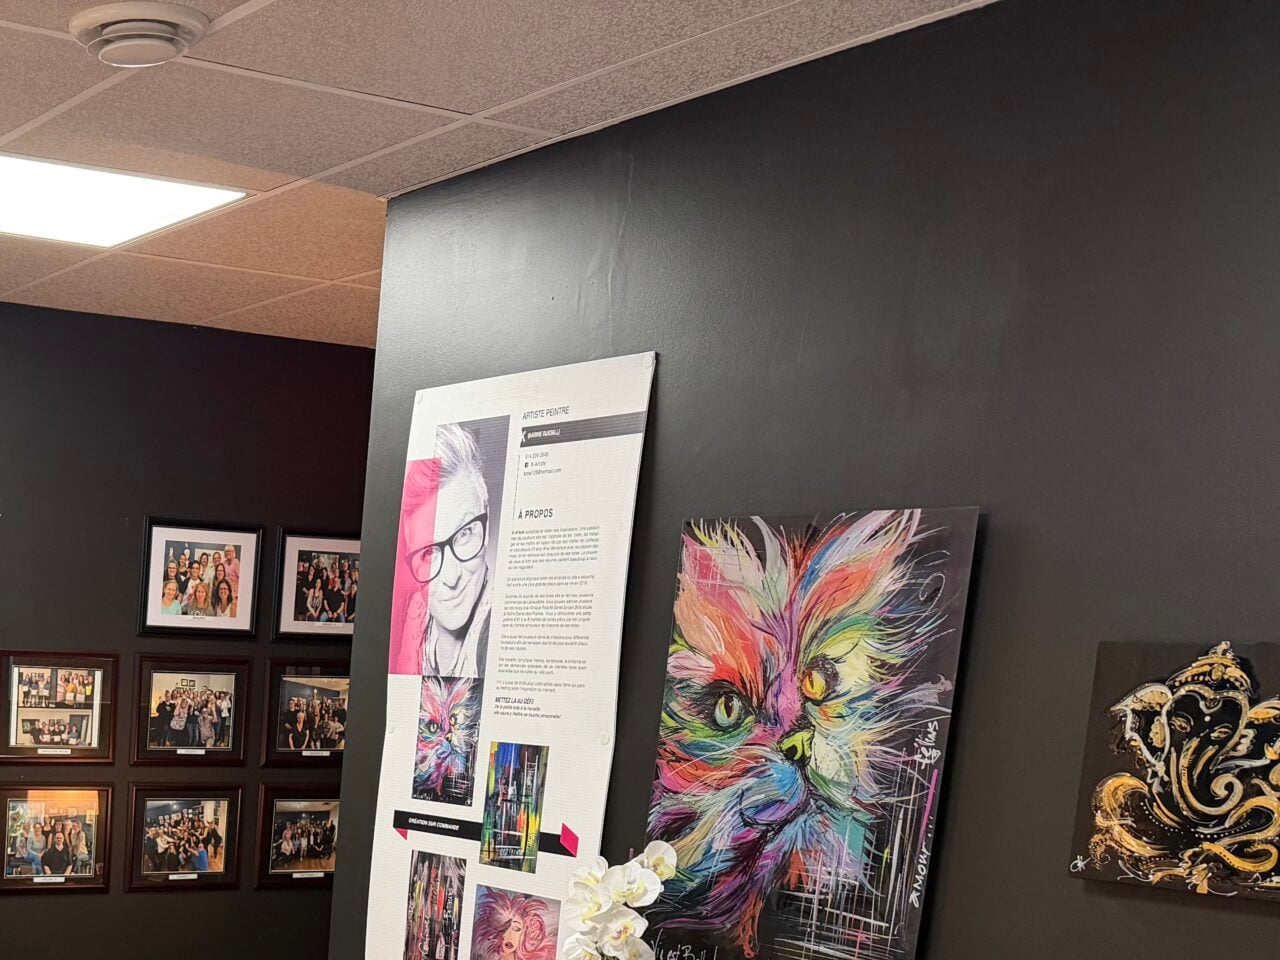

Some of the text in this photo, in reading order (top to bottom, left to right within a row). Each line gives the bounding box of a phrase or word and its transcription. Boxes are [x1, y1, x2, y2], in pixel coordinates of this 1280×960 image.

[522, 406, 570, 421] ARTISTE PEINTRE
[518, 508, 554, 520] À PROPOS
